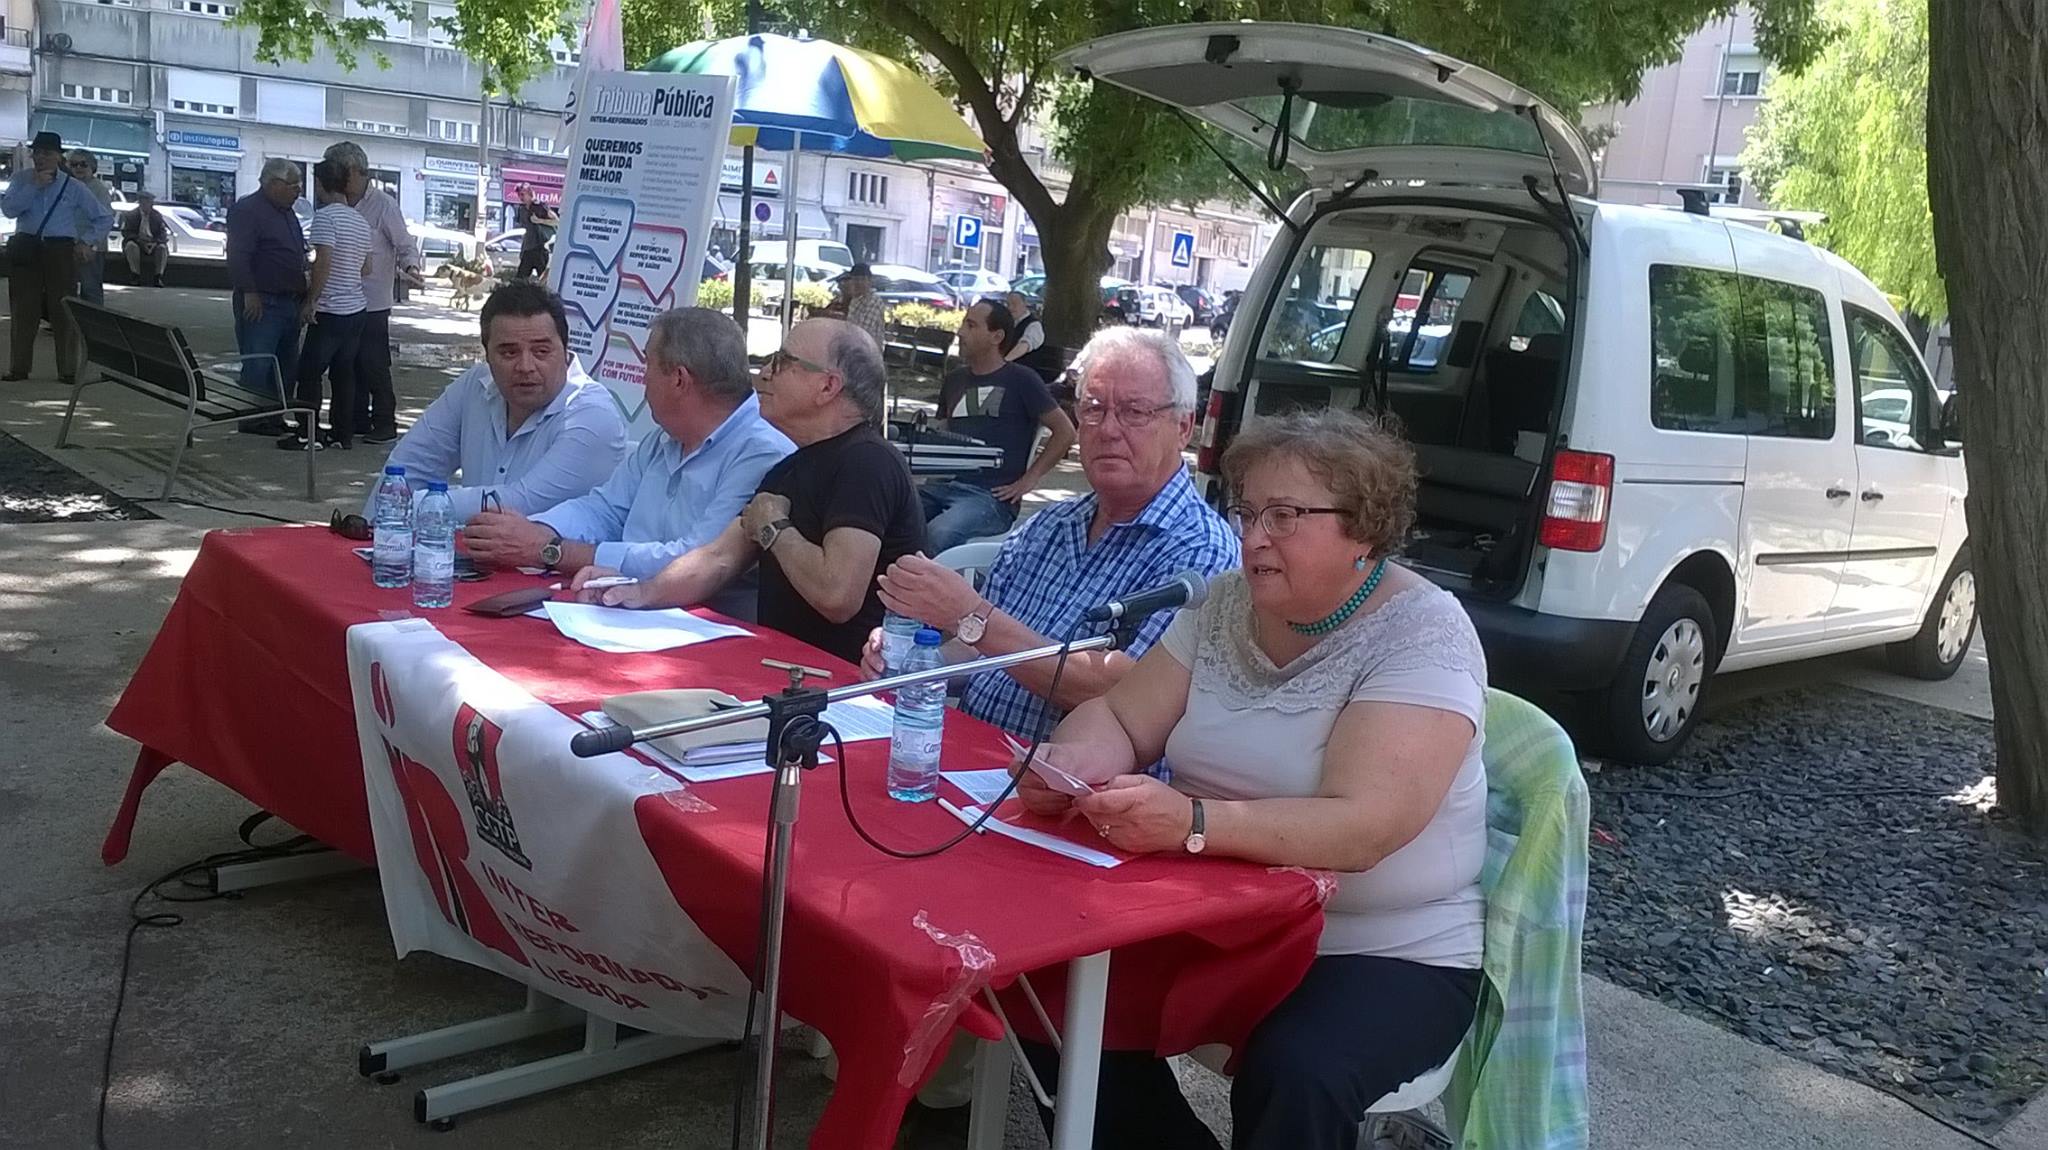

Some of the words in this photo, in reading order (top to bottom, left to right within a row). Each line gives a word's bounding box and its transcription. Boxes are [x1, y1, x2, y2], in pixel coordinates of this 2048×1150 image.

[652, 86, 714, 118] Pública
[585, 138, 643, 155] QUEREMOS
[582, 153, 606, 167] UMA
[608, 155, 633, 169] VIDA
[579, 168, 623, 184] MELHOR
[960, 218, 976, 244] P
[602, 368, 618, 379] COM
[604, 360, 614, 368] POR
[624, 364, 646, 374] PORTUG
[480, 860, 580, 933] INTER
[532, 957, 651, 1010] LISBOA
